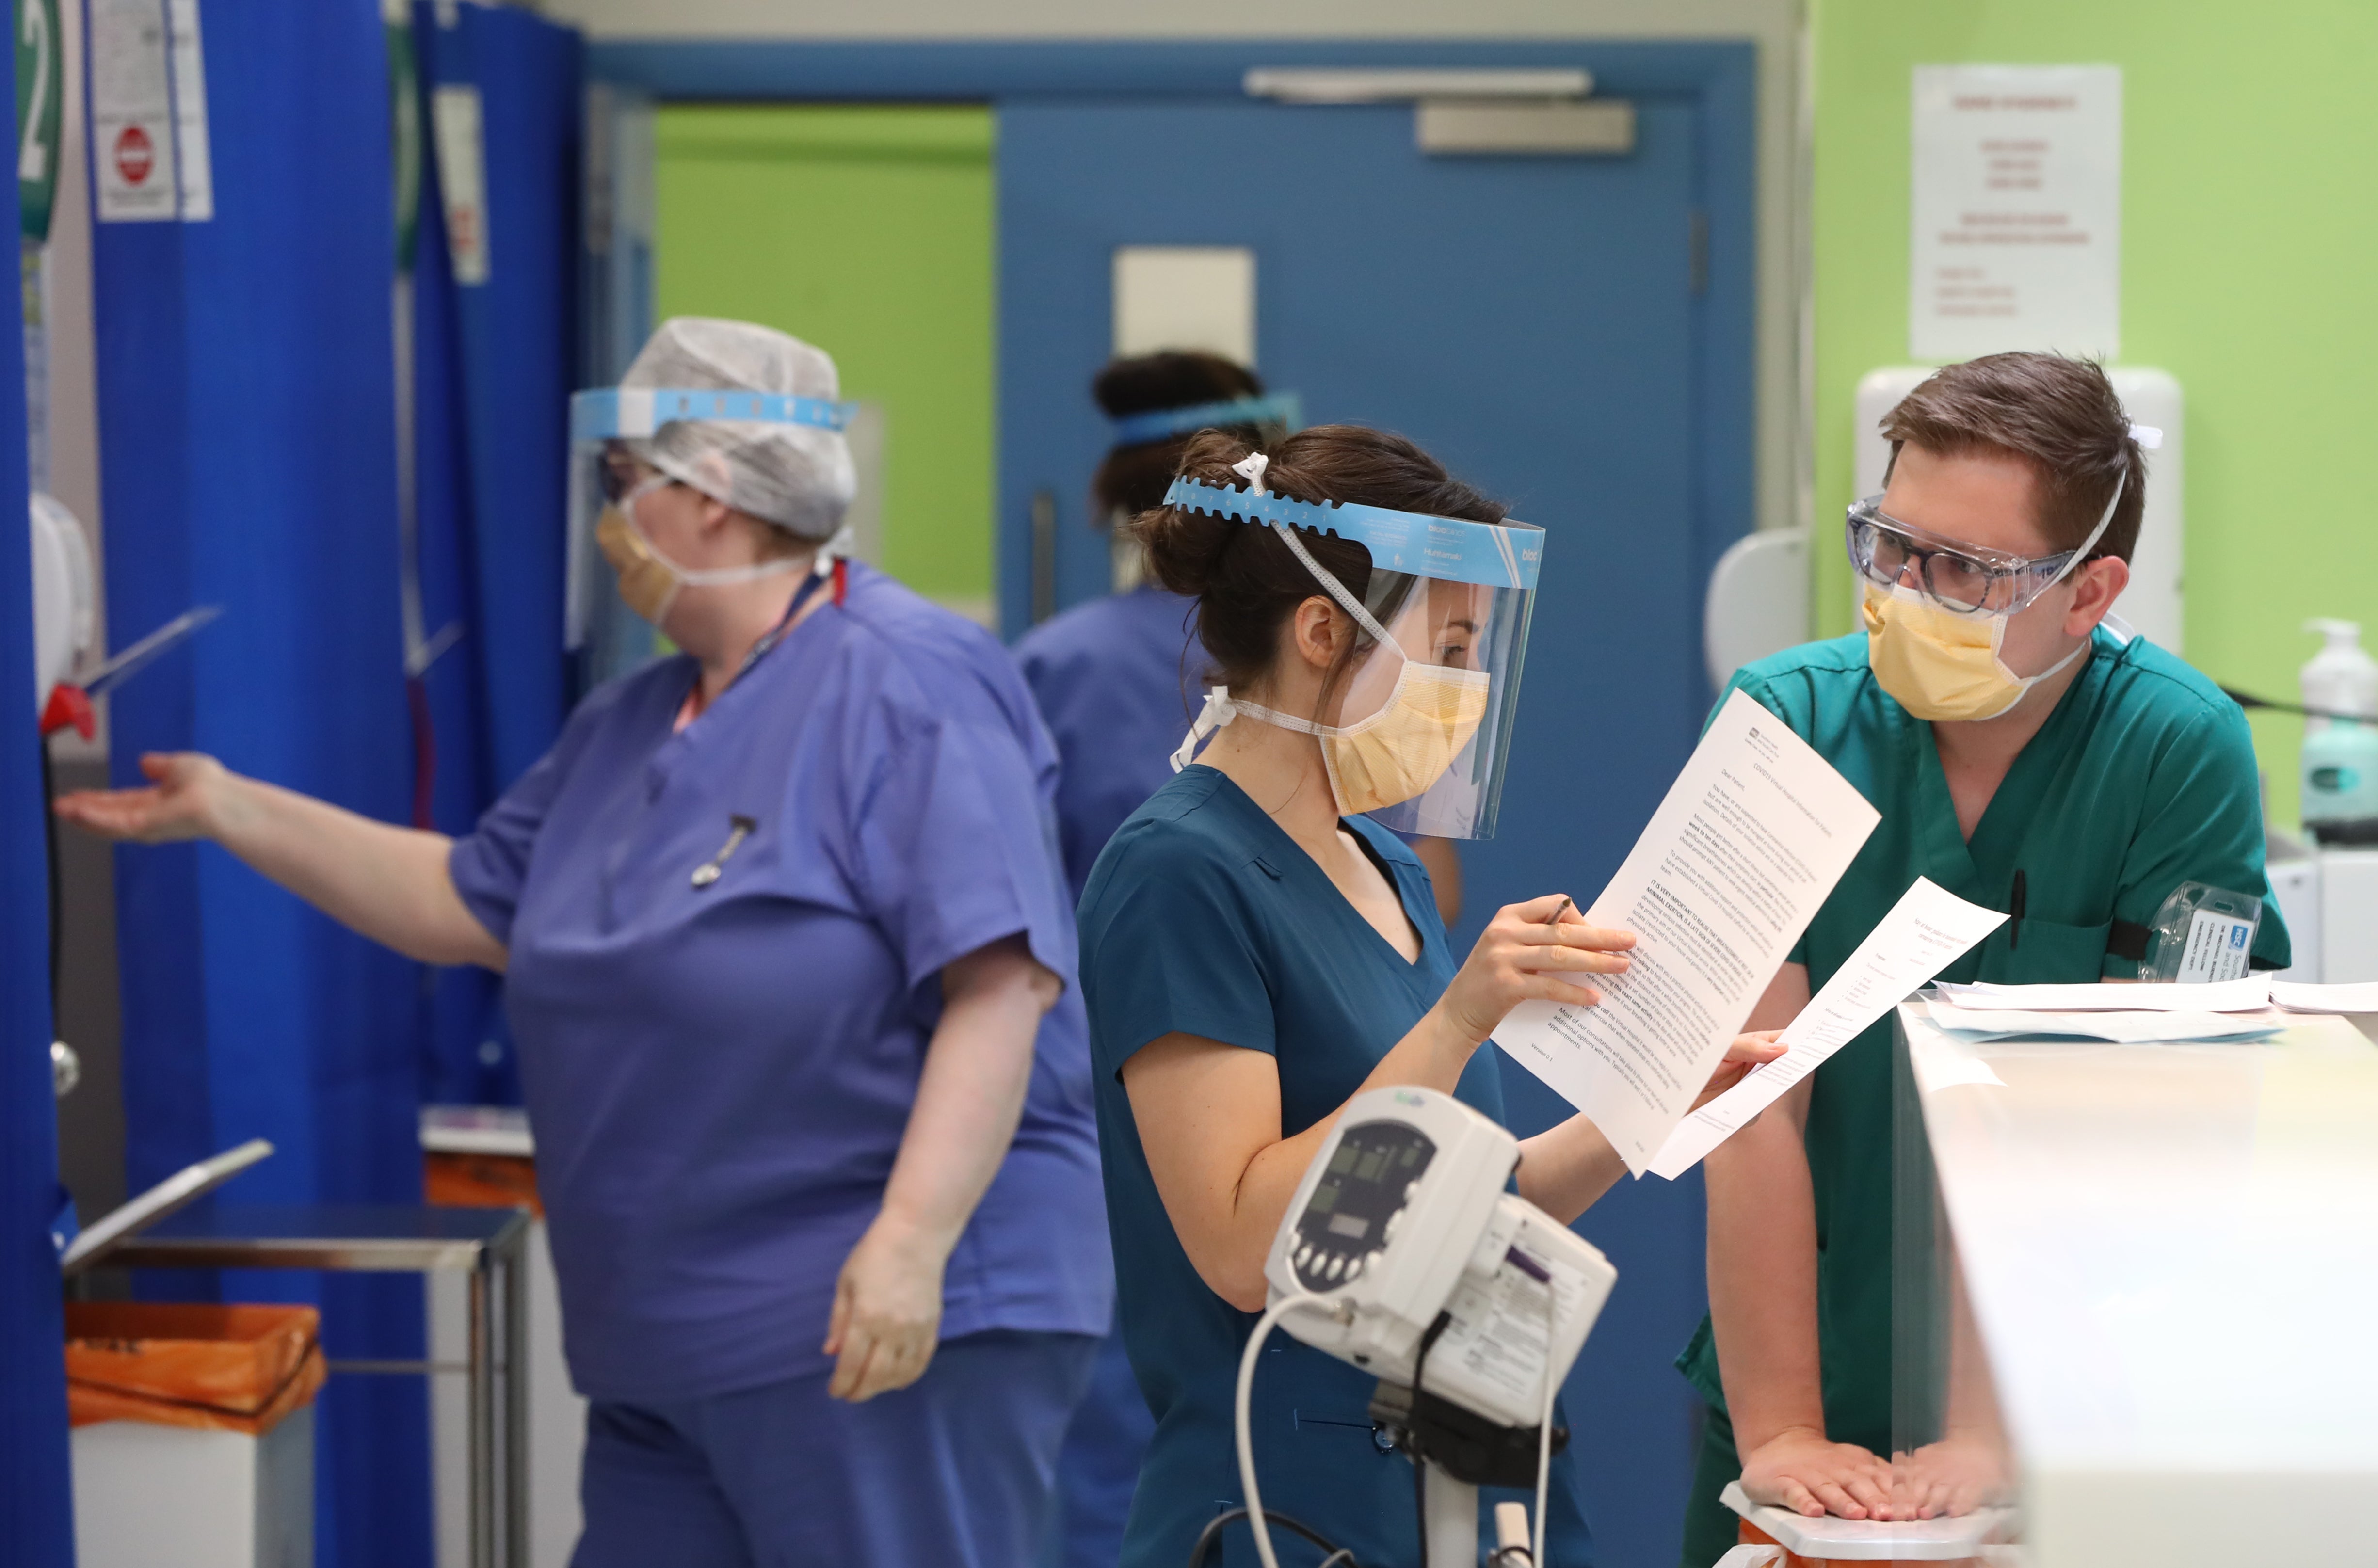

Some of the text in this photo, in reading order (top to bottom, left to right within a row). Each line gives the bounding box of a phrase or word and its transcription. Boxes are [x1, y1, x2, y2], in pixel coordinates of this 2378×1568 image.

[18, 0, 49, 180] 2
[1646, 886, 1666, 905] MINIMAL
[1659, 886, 1671, 897] VERY
[1670, 895, 1692, 916] IMPORTANT
[1626, 915, 1647, 934] physically
[1637, 900, 1645, 910] the
[1643, 907, 1660, 923] primary
[1658, 919, 1667, 928] aim
[1640, 893, 1690, 937] developing serious infection
[1632, 908, 1646, 922] isolate
[1667, 940, 1676, 949] your
[2192, 920, 2204, 955] EMERGENCY
[2233, 928, 2244, 946] HSC
[2200, 922, 2215, 972] CLINICAL FELLOW
[2214, 935, 2223, 959] MICHAEL
[1636, 945, 1671, 978] will discuss with you
[1636, 957, 1651, 972] talking
[1653, 971, 1663, 982] help
[1585, 972, 1609, 992] reference
[1630, 974, 1638, 982] the
[1636, 979, 1652, 995] distance
[1646, 976, 1655, 986] that
[1653, 983, 1664, 994] after
[1613, 983, 1623, 992] this
[1621, 989, 1633, 1001] exact
[1631, 998, 1641, 1009] same
[1637, 992, 1652, 1006] number
[1559, 1007, 1573, 1020] Most
[1577, 1023, 1586, 1031] our
[1586, 1028, 1614, 1053] consultations
[1590, 1009, 1626, 1041] exercise that when
[1600, 1006, 1610, 1015] call
[1608, 1012, 1617, 1021] the
[1615, 1017, 1628, 1031] Virtual
[1553, 1013, 1578, 1036] additional
[1576, 1032, 1595, 1050] options
[1593, 1046, 1604, 1056] with
[1531, 1042, 1547, 1056] Version
